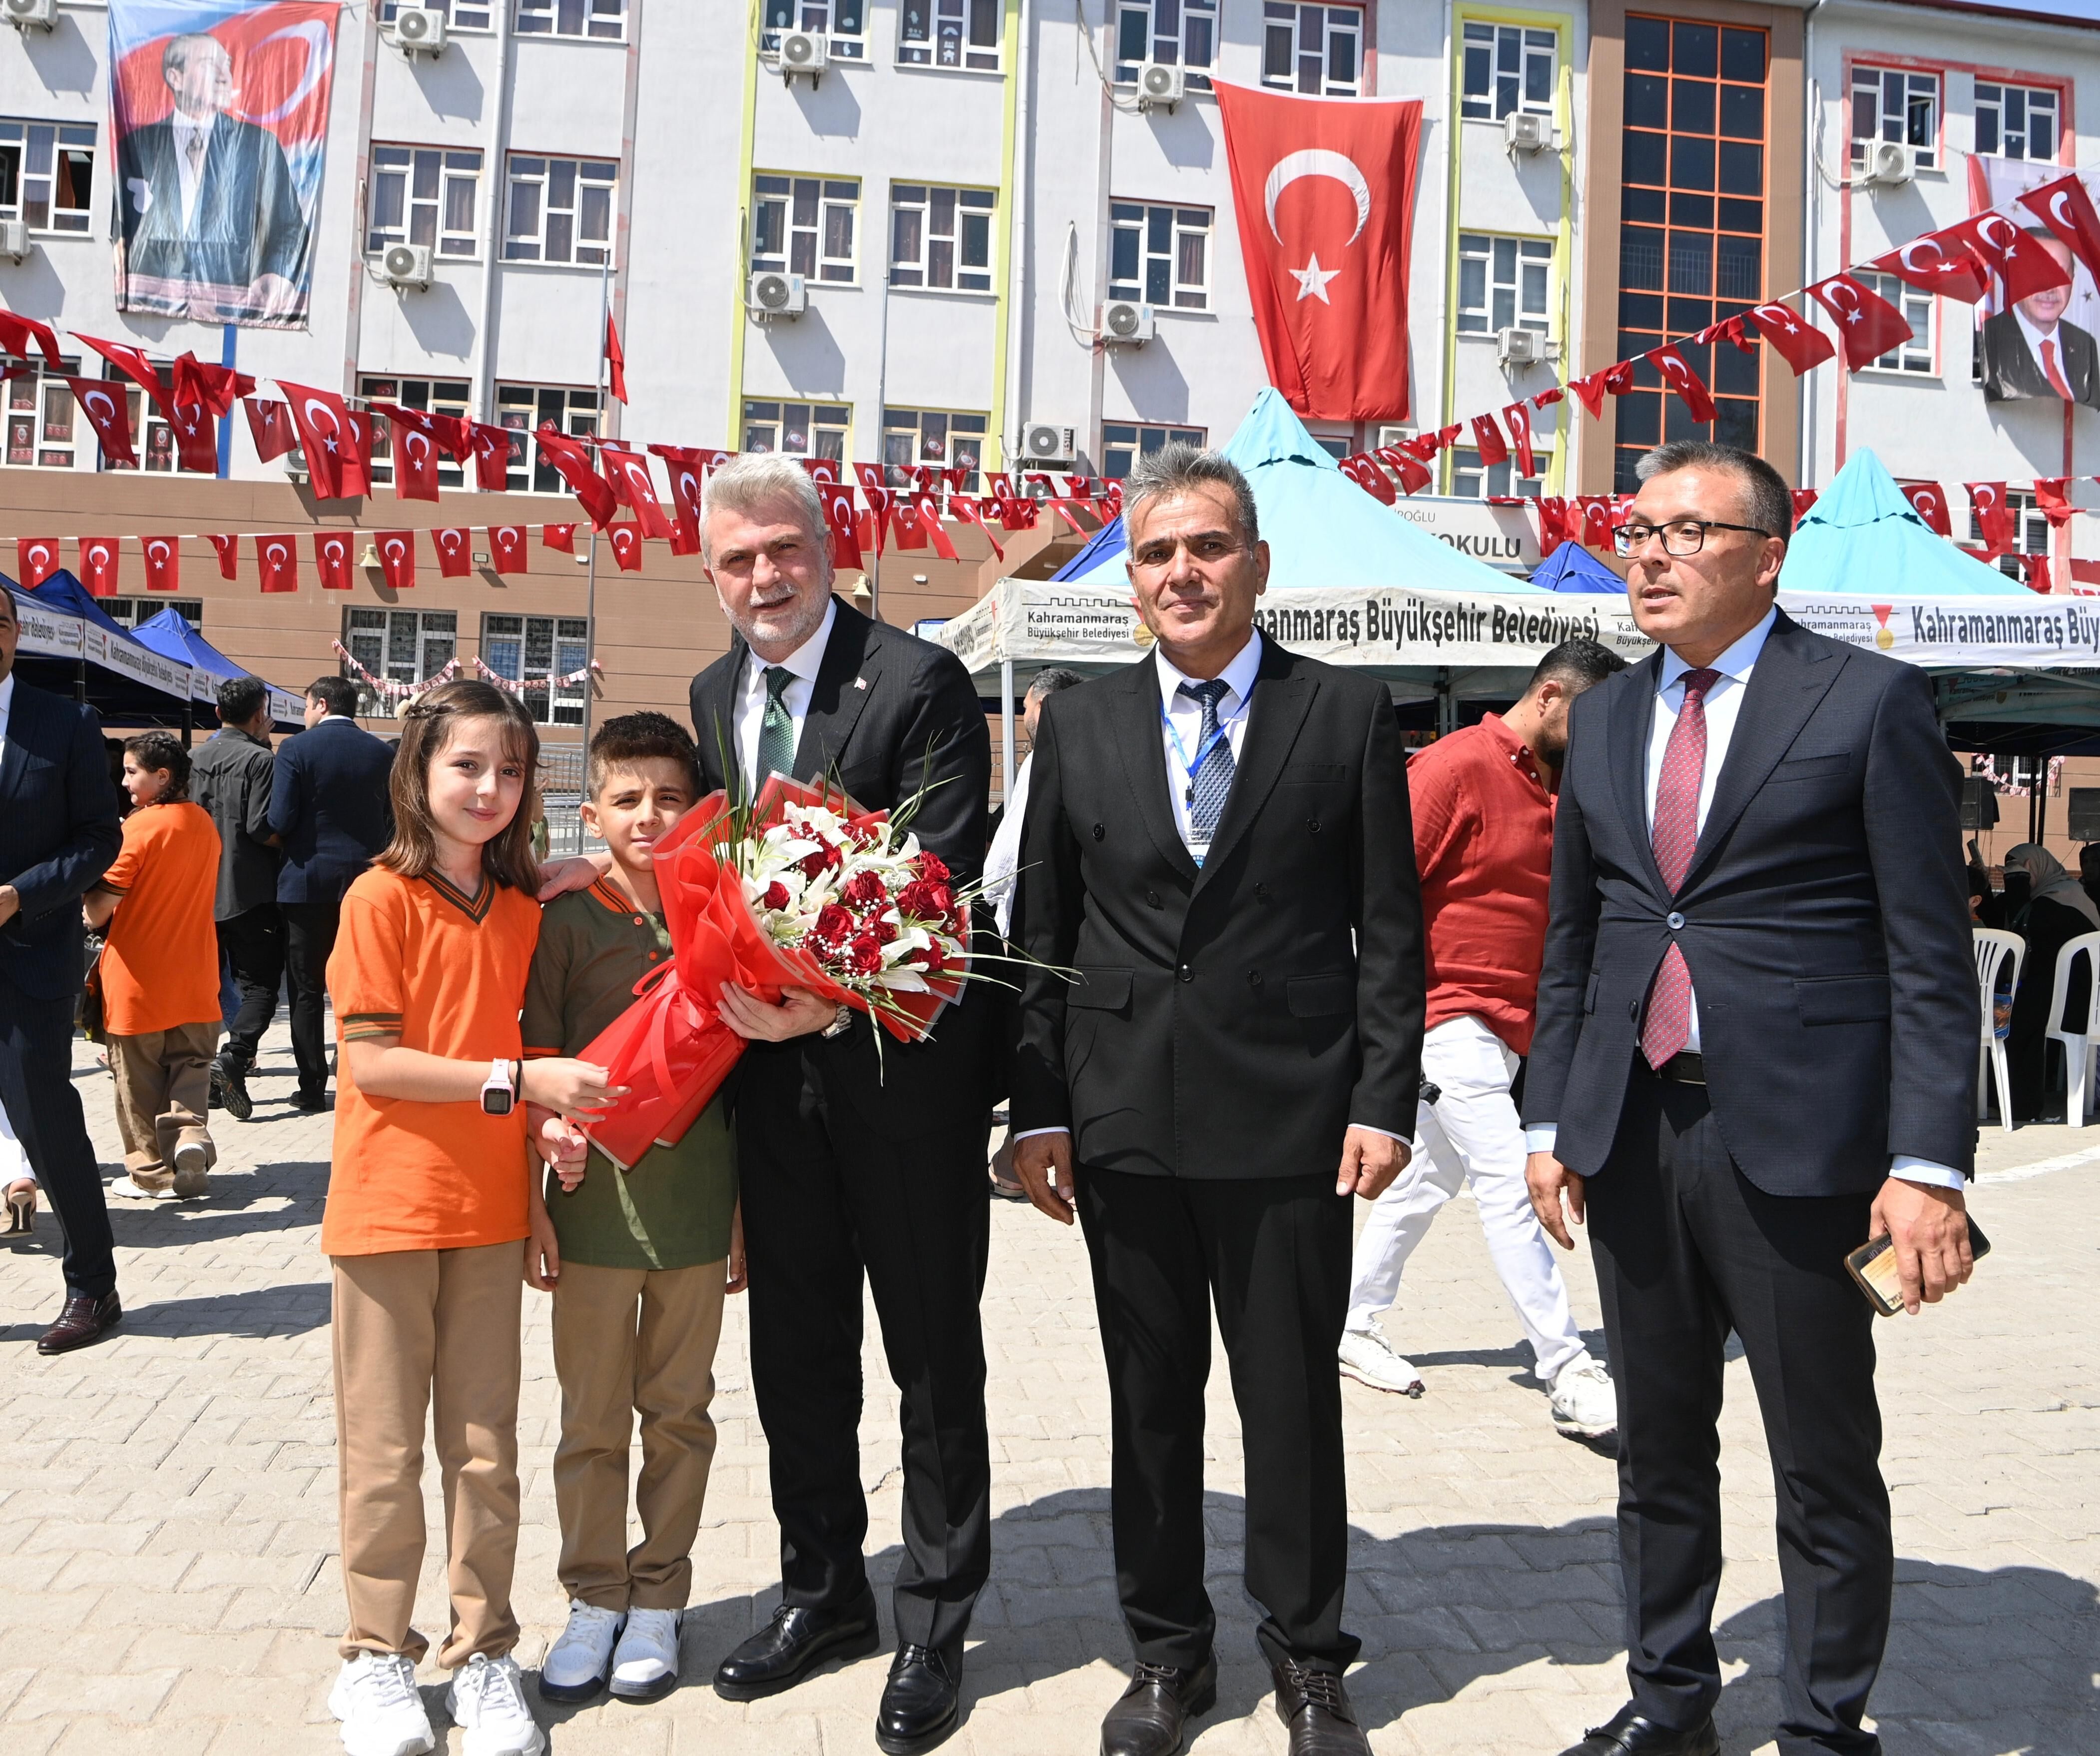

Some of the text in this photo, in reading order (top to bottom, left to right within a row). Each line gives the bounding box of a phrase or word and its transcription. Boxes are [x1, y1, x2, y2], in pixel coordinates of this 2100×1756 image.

[1028, 611, 1129, 626] Kahramanmaraş
[1367, 598, 1487, 650] Büyükşehir
[1493, 605, 1599, 643] Belediyesi
[1912, 605, 2064, 649] Kahramanmaraş
[1028, 627, 1129, 640] Büyükşehir Belediyesi
